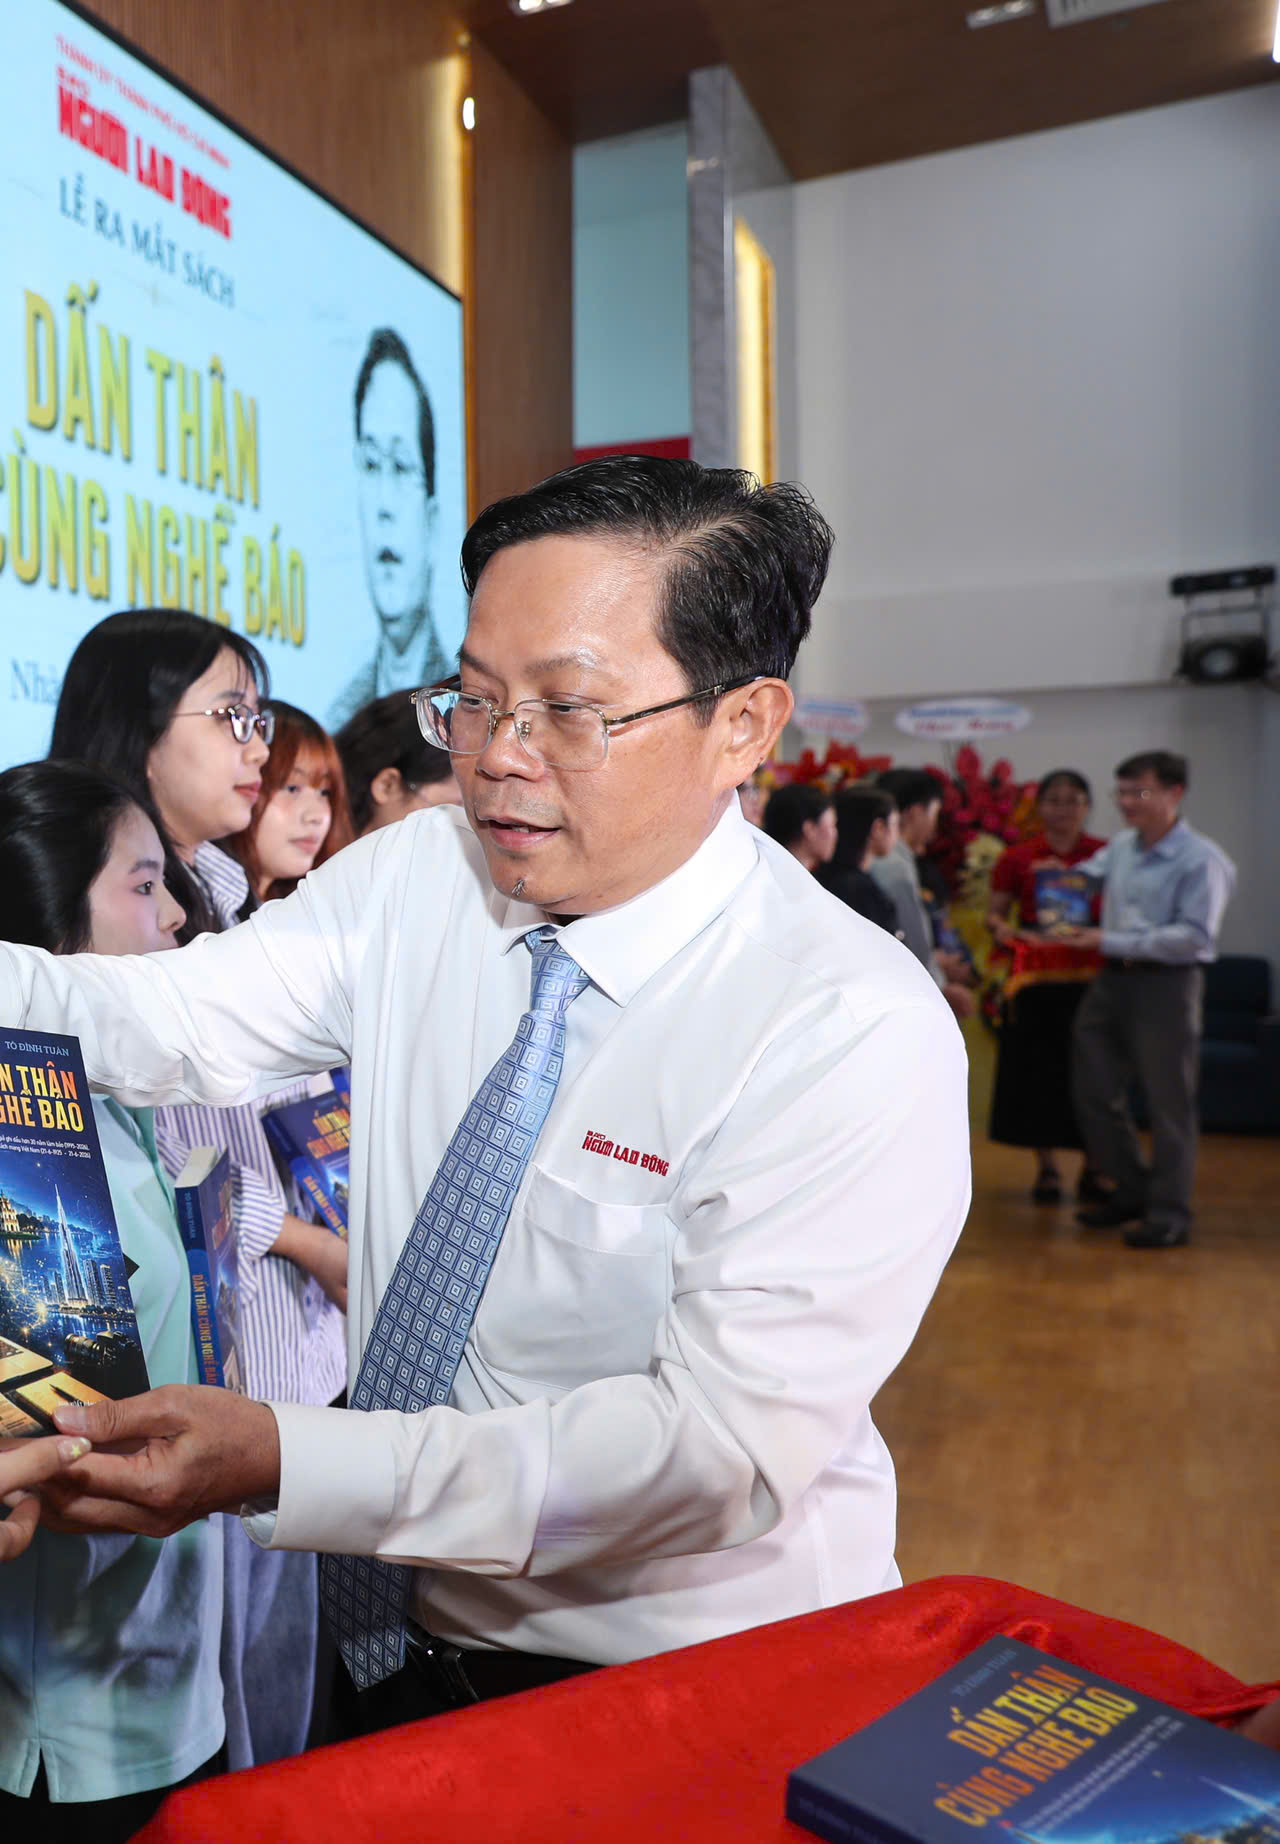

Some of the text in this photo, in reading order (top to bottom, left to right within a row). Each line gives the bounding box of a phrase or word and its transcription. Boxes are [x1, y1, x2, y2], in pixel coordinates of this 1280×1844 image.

[136, 136, 174, 203] LAO
[95, 198, 125, 246] RA
[183, 250, 235, 307] SÁCH
[24, 280, 259, 509] DẤN THÂN
[124, 492, 236, 626] NGHỀ
[243, 523, 306, 648] BÁO
[5, 1040, 69, 1057] TÔ ĐÌNH TUÂN
[16, 1060, 78, 1100] THÂN
[37, 1092, 85, 1132] BÁO
[613, 1145, 640, 1165] LAO
[947, 1706, 1029, 1758] DẤN
[993, 1664, 1086, 1718] THÂN
[934, 1766, 1035, 1827] CÙNG
[999, 1712, 1096, 1783] NGHỀ
[1057, 1687, 1138, 1736] BÁO
